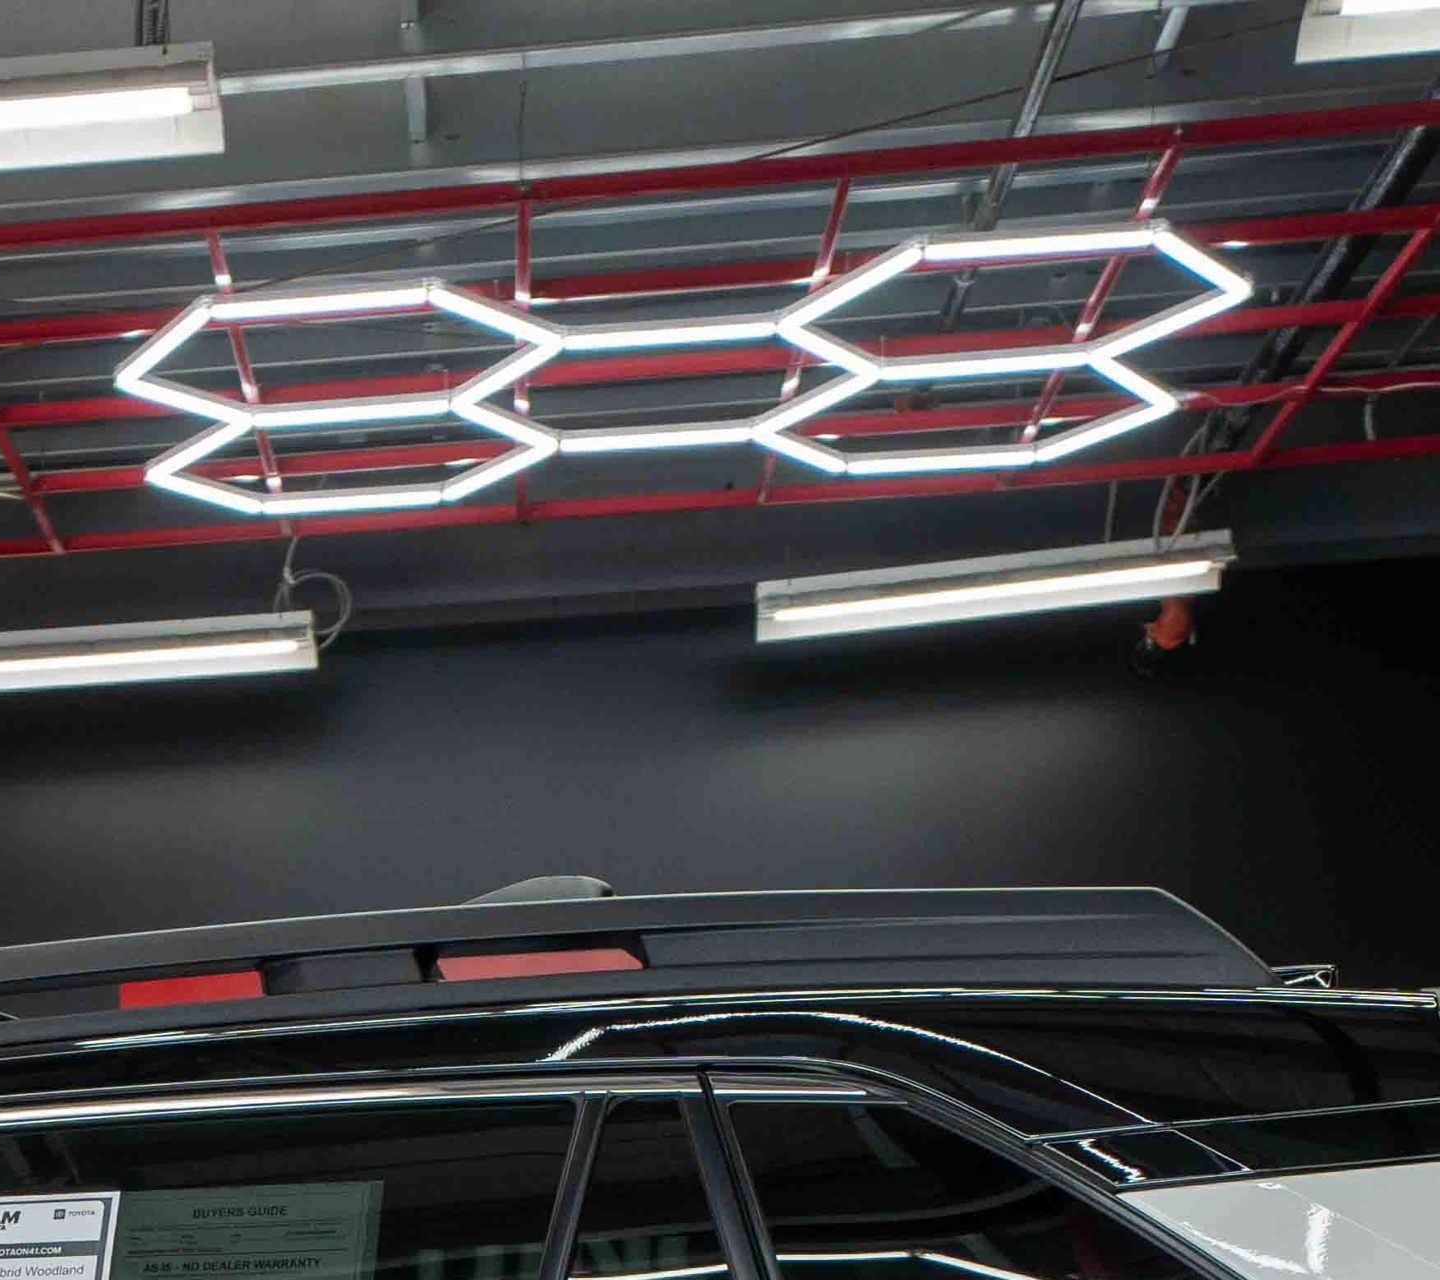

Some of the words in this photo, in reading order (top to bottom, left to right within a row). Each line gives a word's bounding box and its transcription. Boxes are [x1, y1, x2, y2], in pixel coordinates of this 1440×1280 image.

[247, 1205, 288, 1216] GUIDE
[24, 1264, 85, 1276] Woodland
[183, 1261, 201, 1271] NO
[203, 1260, 251, 1271] DEALER
[254, 1258, 321, 1269] WARRANTY
